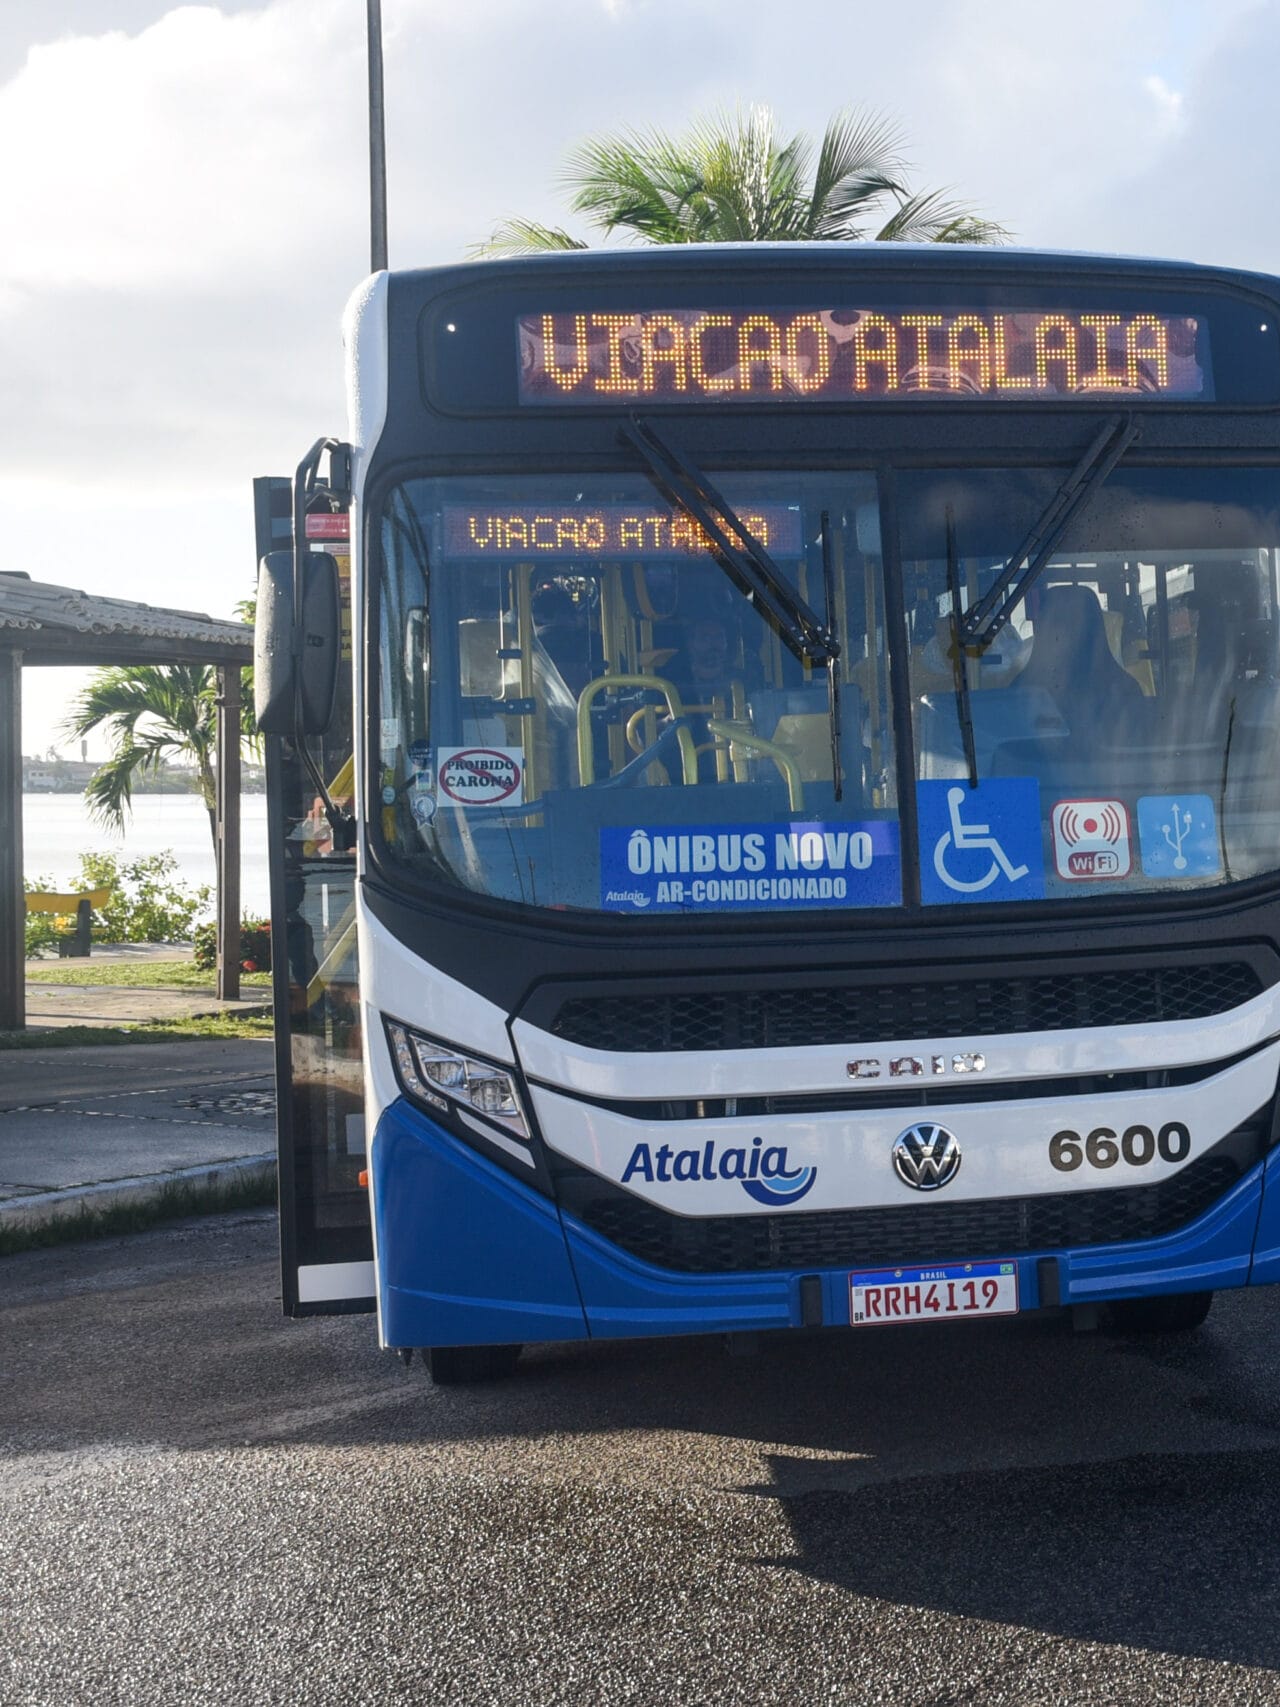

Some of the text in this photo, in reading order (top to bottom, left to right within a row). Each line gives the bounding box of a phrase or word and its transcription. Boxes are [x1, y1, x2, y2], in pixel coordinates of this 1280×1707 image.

[542, 314, 1168, 390] VIACAO ATALAIA
[469, 517, 605, 548] VIACAO
[447, 759, 514, 771] PROIBIDO
[445, 775, 514, 788] CARONA
[627, 829, 873, 875] ÔNIBUS NOVO
[606, 889, 648, 903] Atalaia
[656, 876, 847, 903] AR-CONDICIONADO
[846, 1053, 987, 1079] CAIO
[620, 1136, 803, 1183] Atalaia
[1048, 1121, 1192, 1172] 6600
[919, 1271, 948, 1281] BRASIL
[864, 1279, 999, 1318] RRH4I19
[854, 1311, 865, 1322] BR
